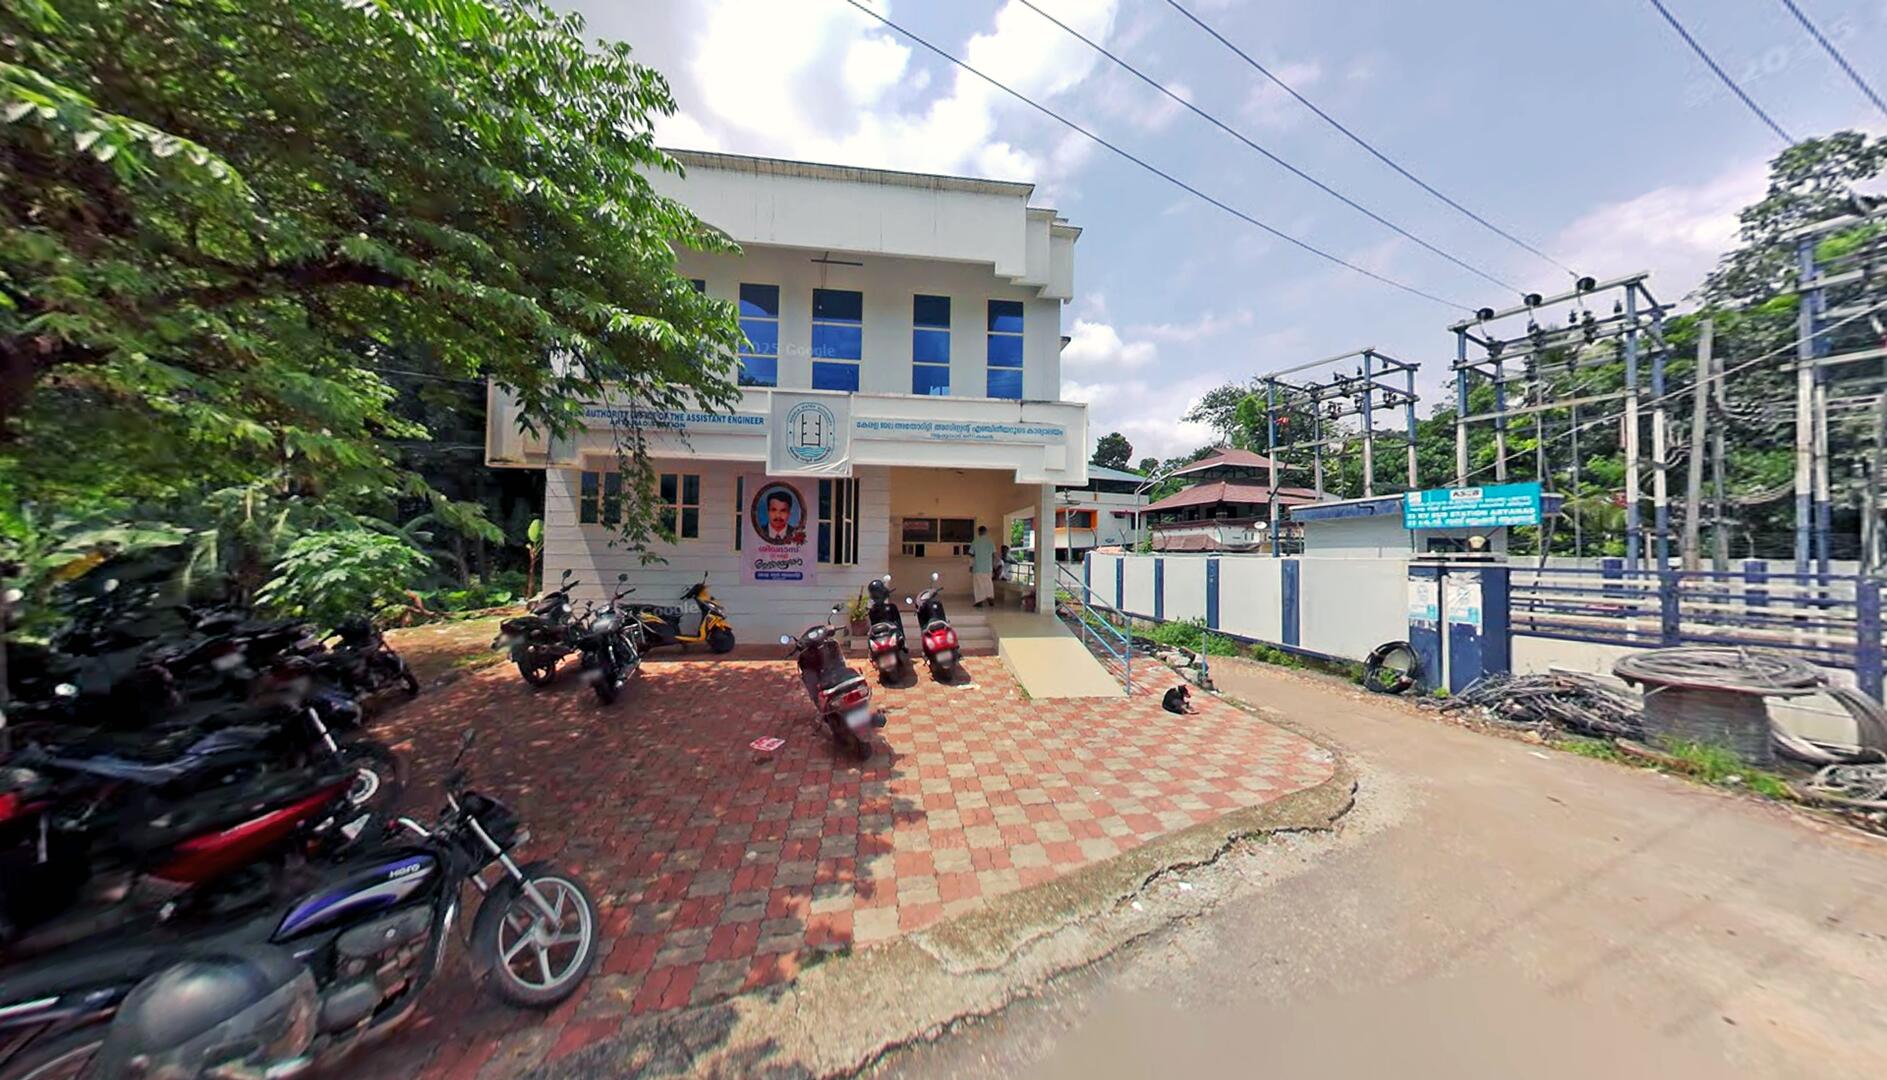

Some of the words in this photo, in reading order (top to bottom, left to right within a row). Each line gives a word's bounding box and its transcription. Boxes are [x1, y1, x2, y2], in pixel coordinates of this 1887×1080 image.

[671, 412, 685, 422] THE
[687, 413, 727, 424] ASSISTANT
[728, 415, 765, 425] ENGINEER
